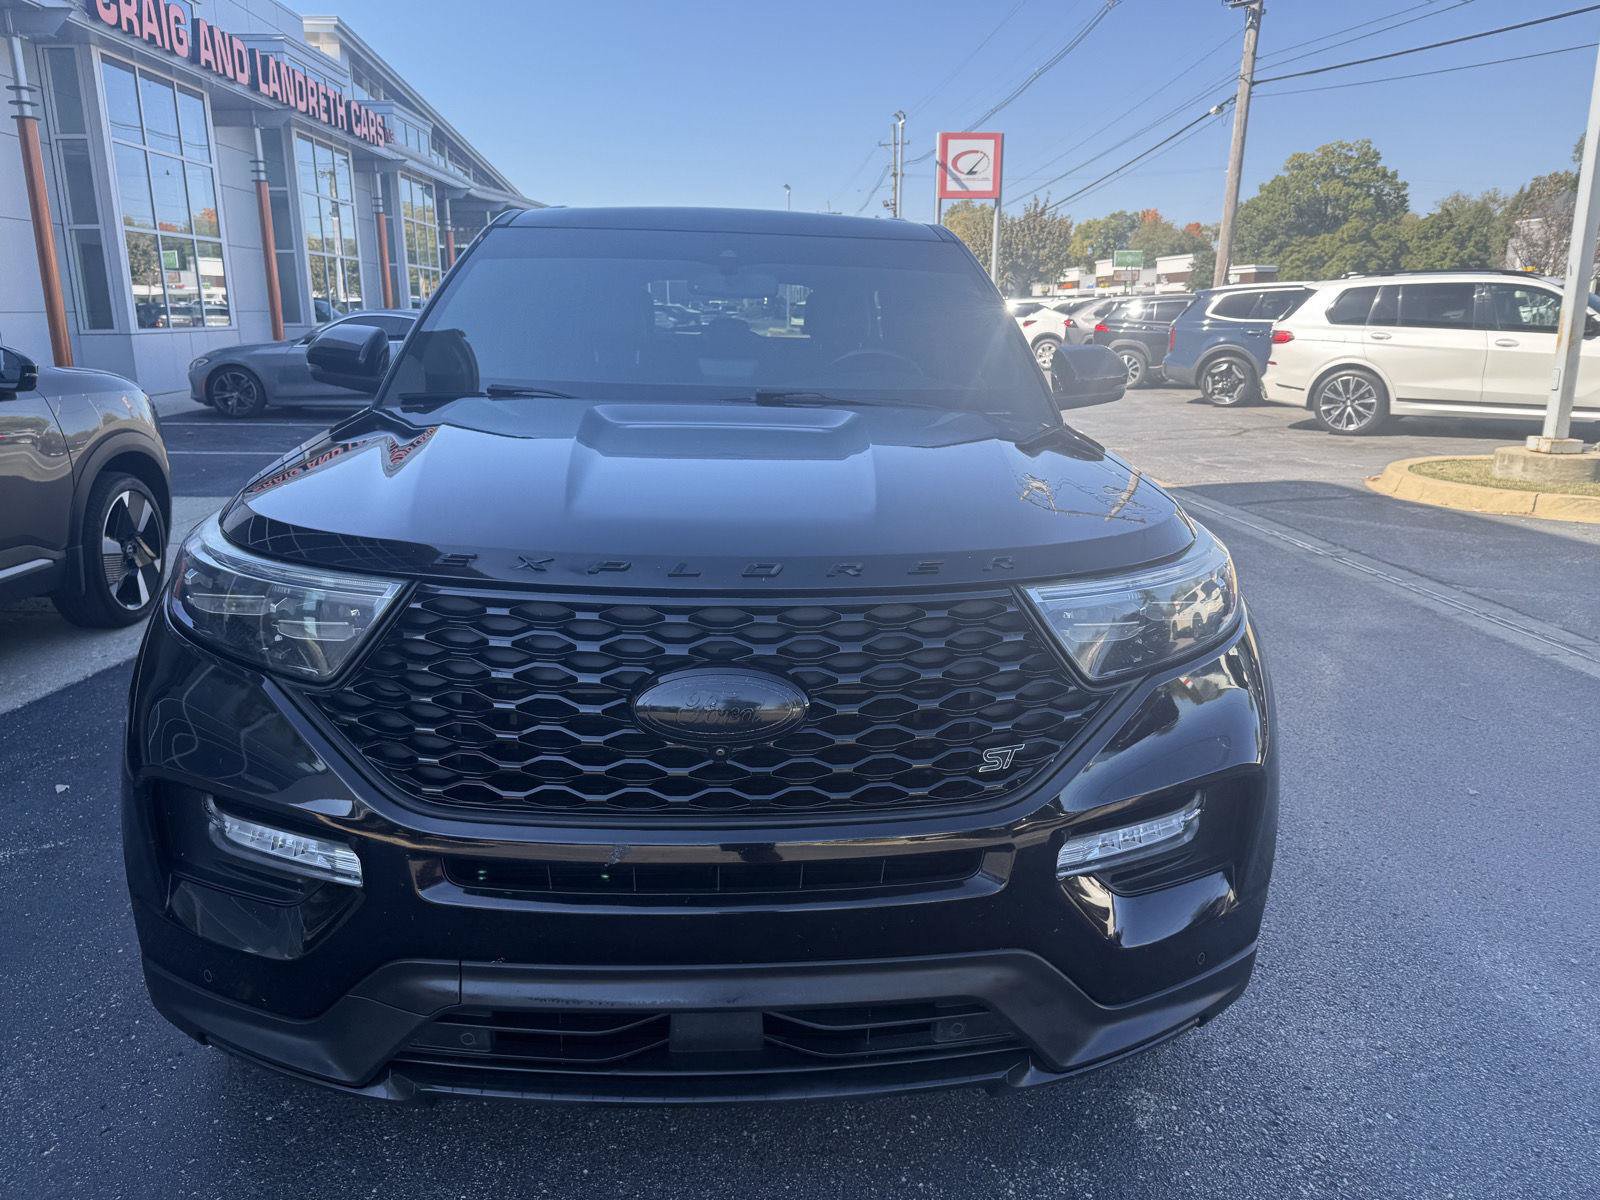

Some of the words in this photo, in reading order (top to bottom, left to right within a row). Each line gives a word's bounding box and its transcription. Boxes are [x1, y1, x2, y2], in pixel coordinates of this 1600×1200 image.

[198, 18, 250, 86] AND
[256, 48, 348, 131] LANDRETH
[351, 100, 385, 148] CARS
[430, 553, 1015, 578] EXPLORER
[979, 743, 1026, 772] ST
